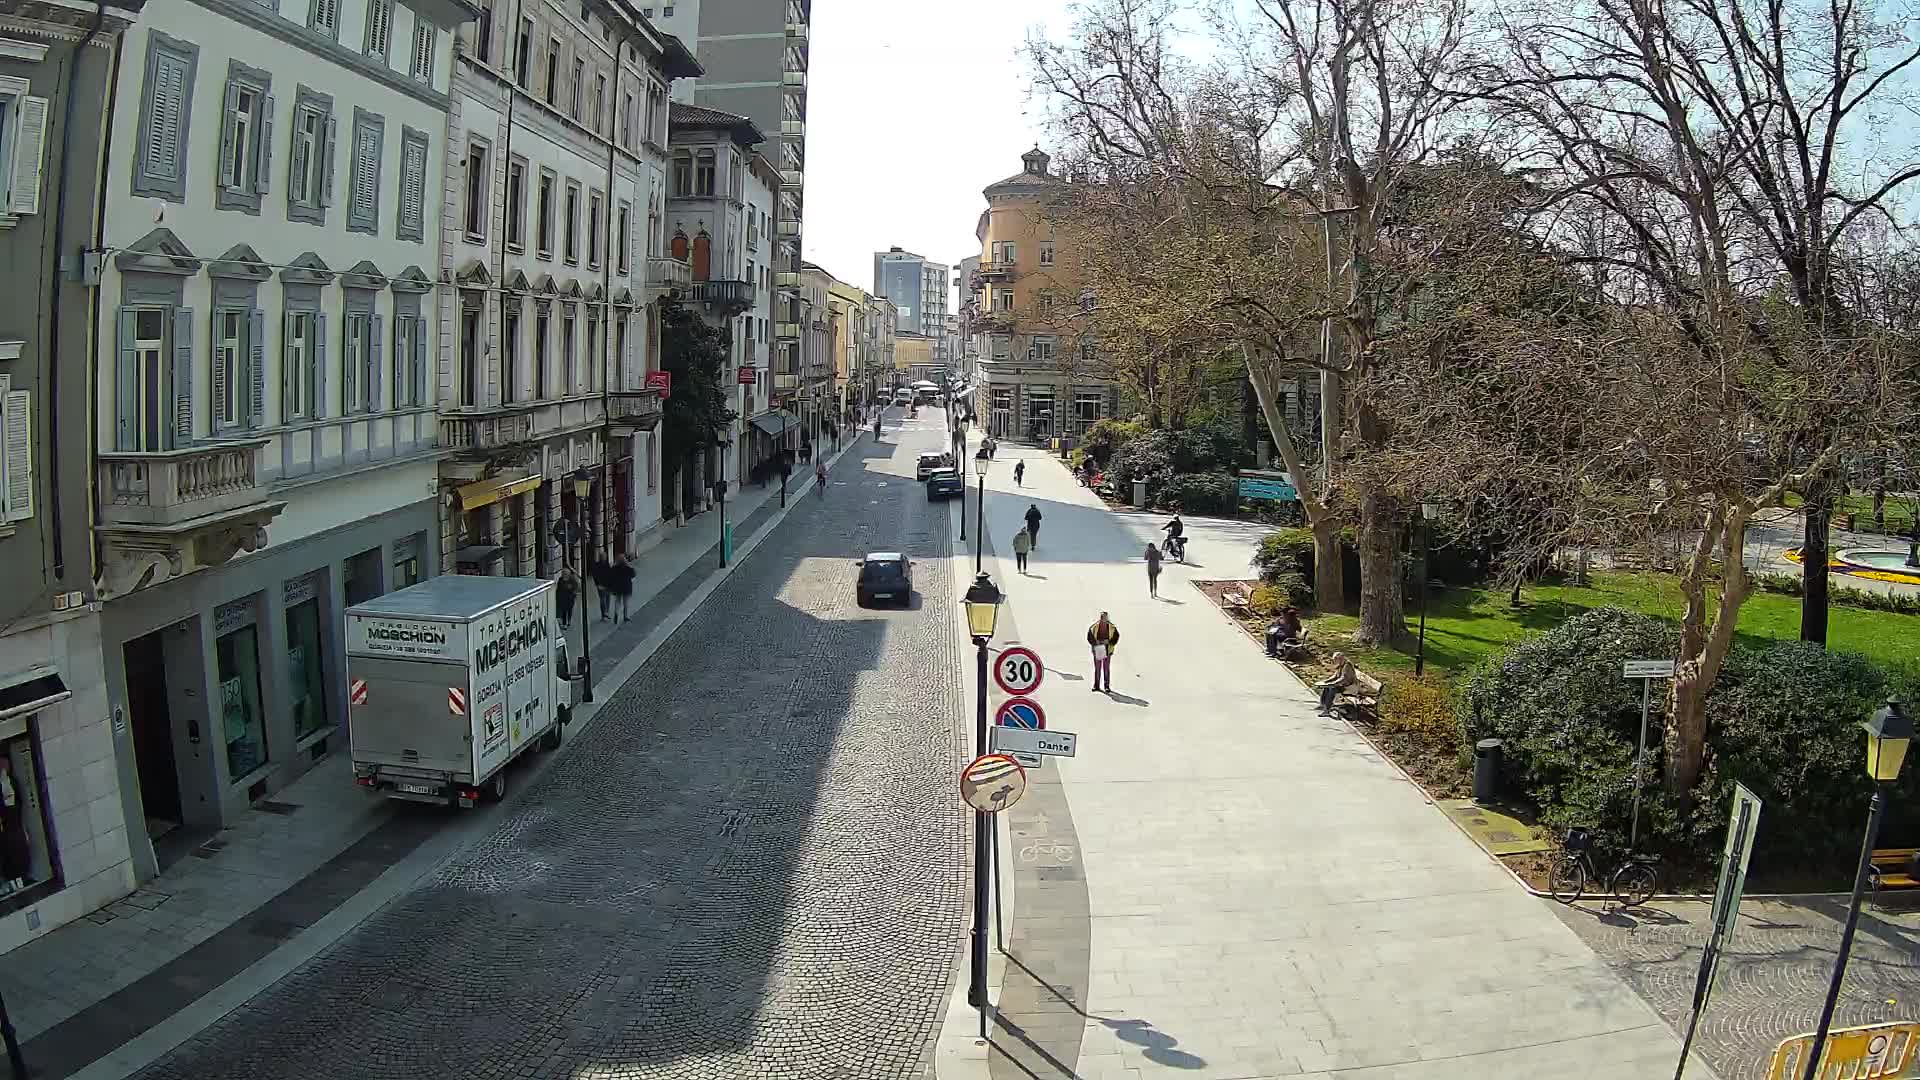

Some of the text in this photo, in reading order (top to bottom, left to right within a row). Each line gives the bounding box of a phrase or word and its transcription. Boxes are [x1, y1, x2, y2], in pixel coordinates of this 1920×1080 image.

[480, 599, 544, 640] TRASLOCHI
[368, 627, 446, 645] MOSCHION
[476, 615, 547, 676] MOSCHION
[1005, 660, 1033, 682] 30
[1038, 740, 1071, 752] Dante
